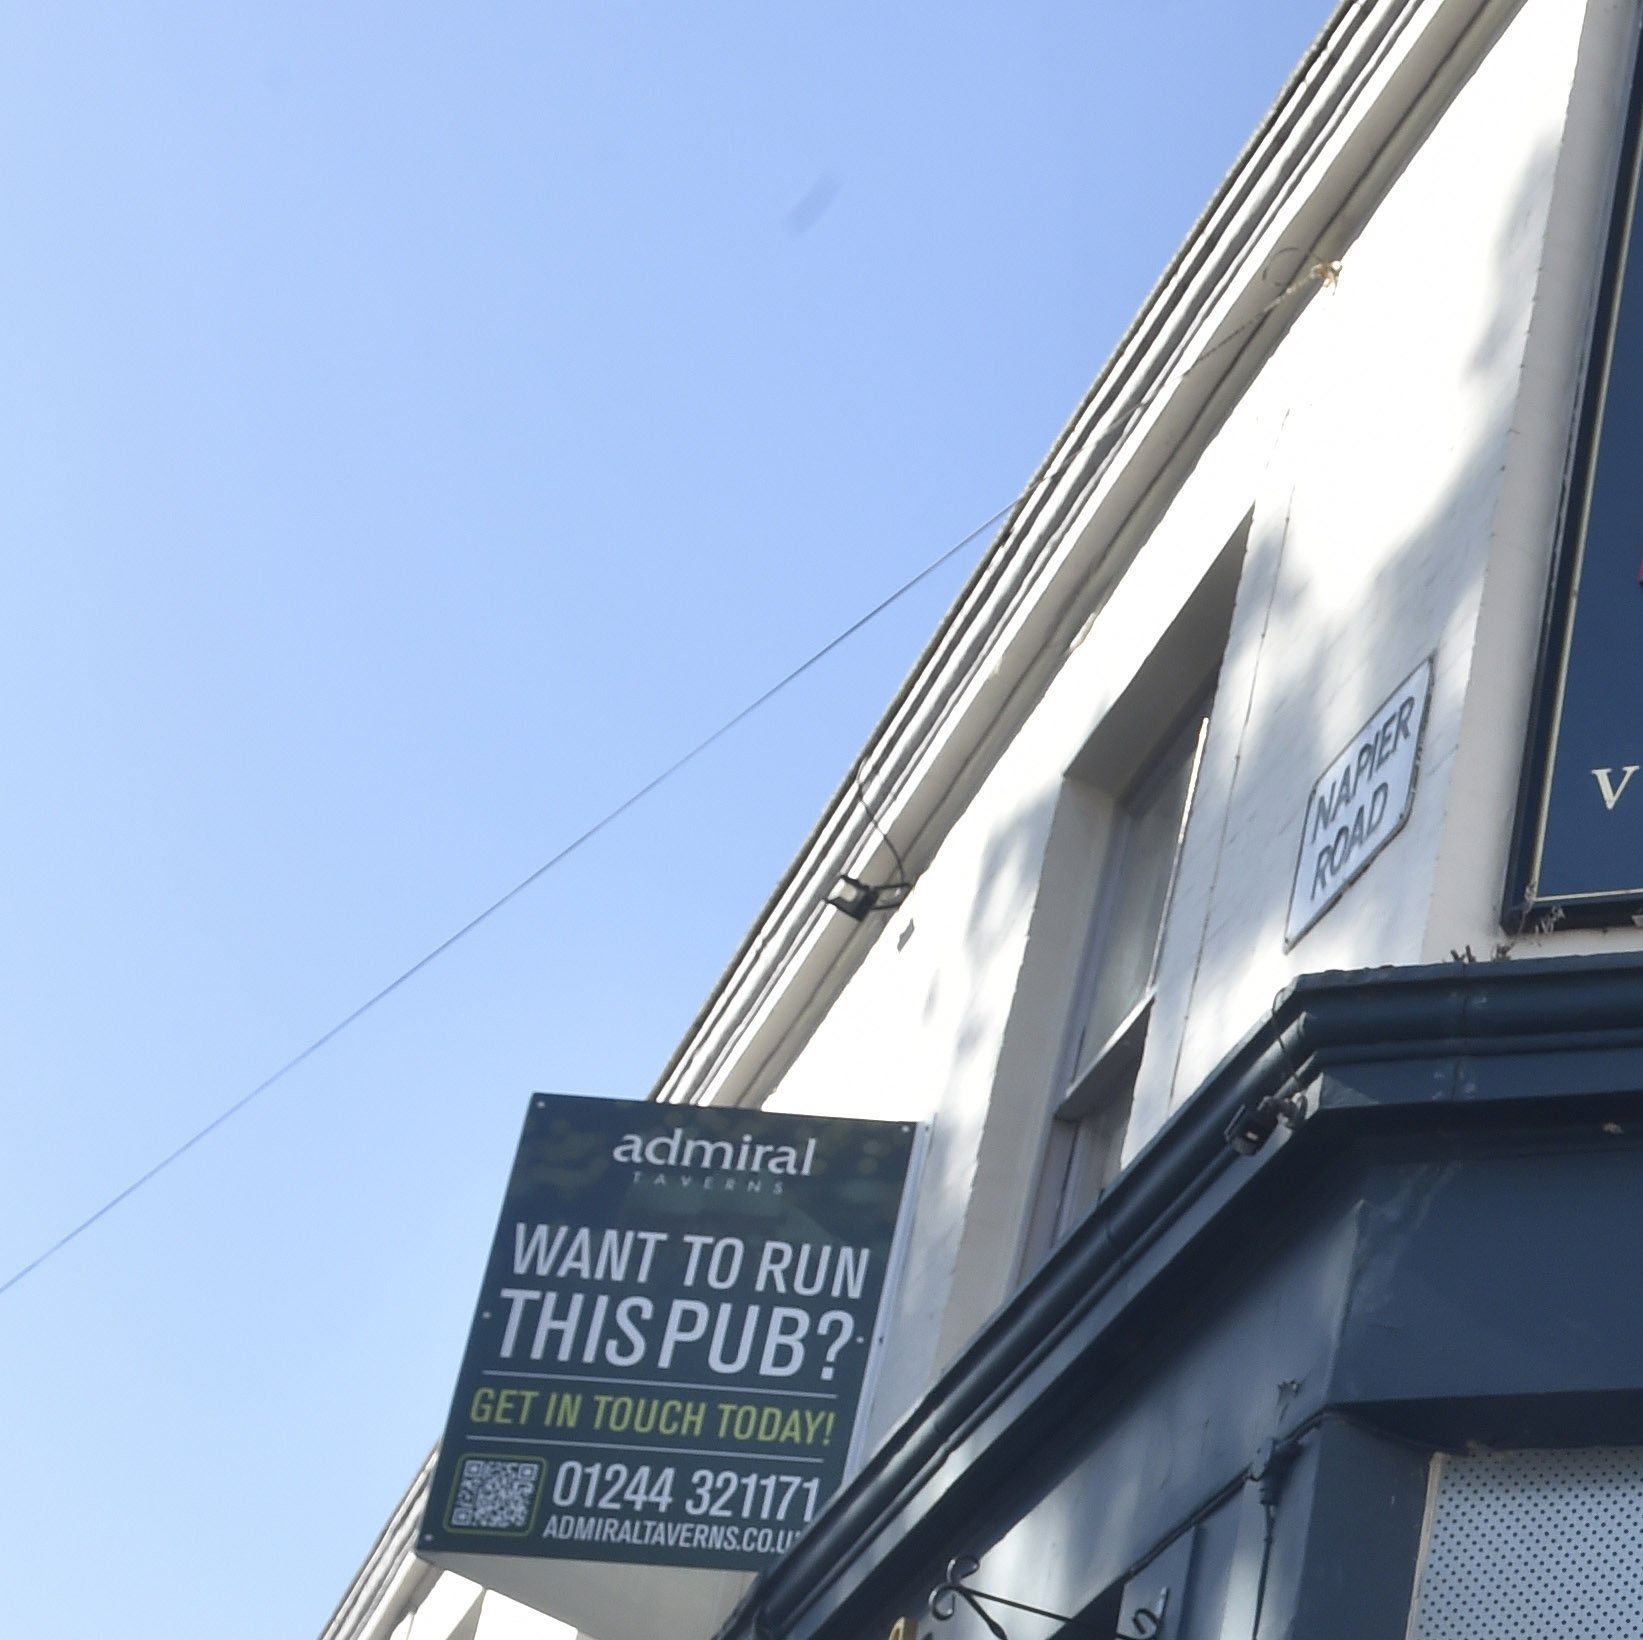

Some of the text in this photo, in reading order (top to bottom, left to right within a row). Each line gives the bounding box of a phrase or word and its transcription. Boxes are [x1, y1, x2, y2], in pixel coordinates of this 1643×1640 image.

[1311, 696, 1415, 845] NAPIER
[1310, 782, 1388, 901] ROAD
[613, 1128, 815, 1176] admiral
[633, 1171, 784, 1195] TAVERNS
[513, 1222, 869, 1298] WANT TO RUN
[498, 1288, 855, 1380] THIS PUB?
[470, 1388, 837, 1445] GET IN TOUCH TODAY!
[552, 1460, 821, 1523] 01244 321171
[543, 1514, 801, 1555] ADMIRALTAVERNS.CO.U
